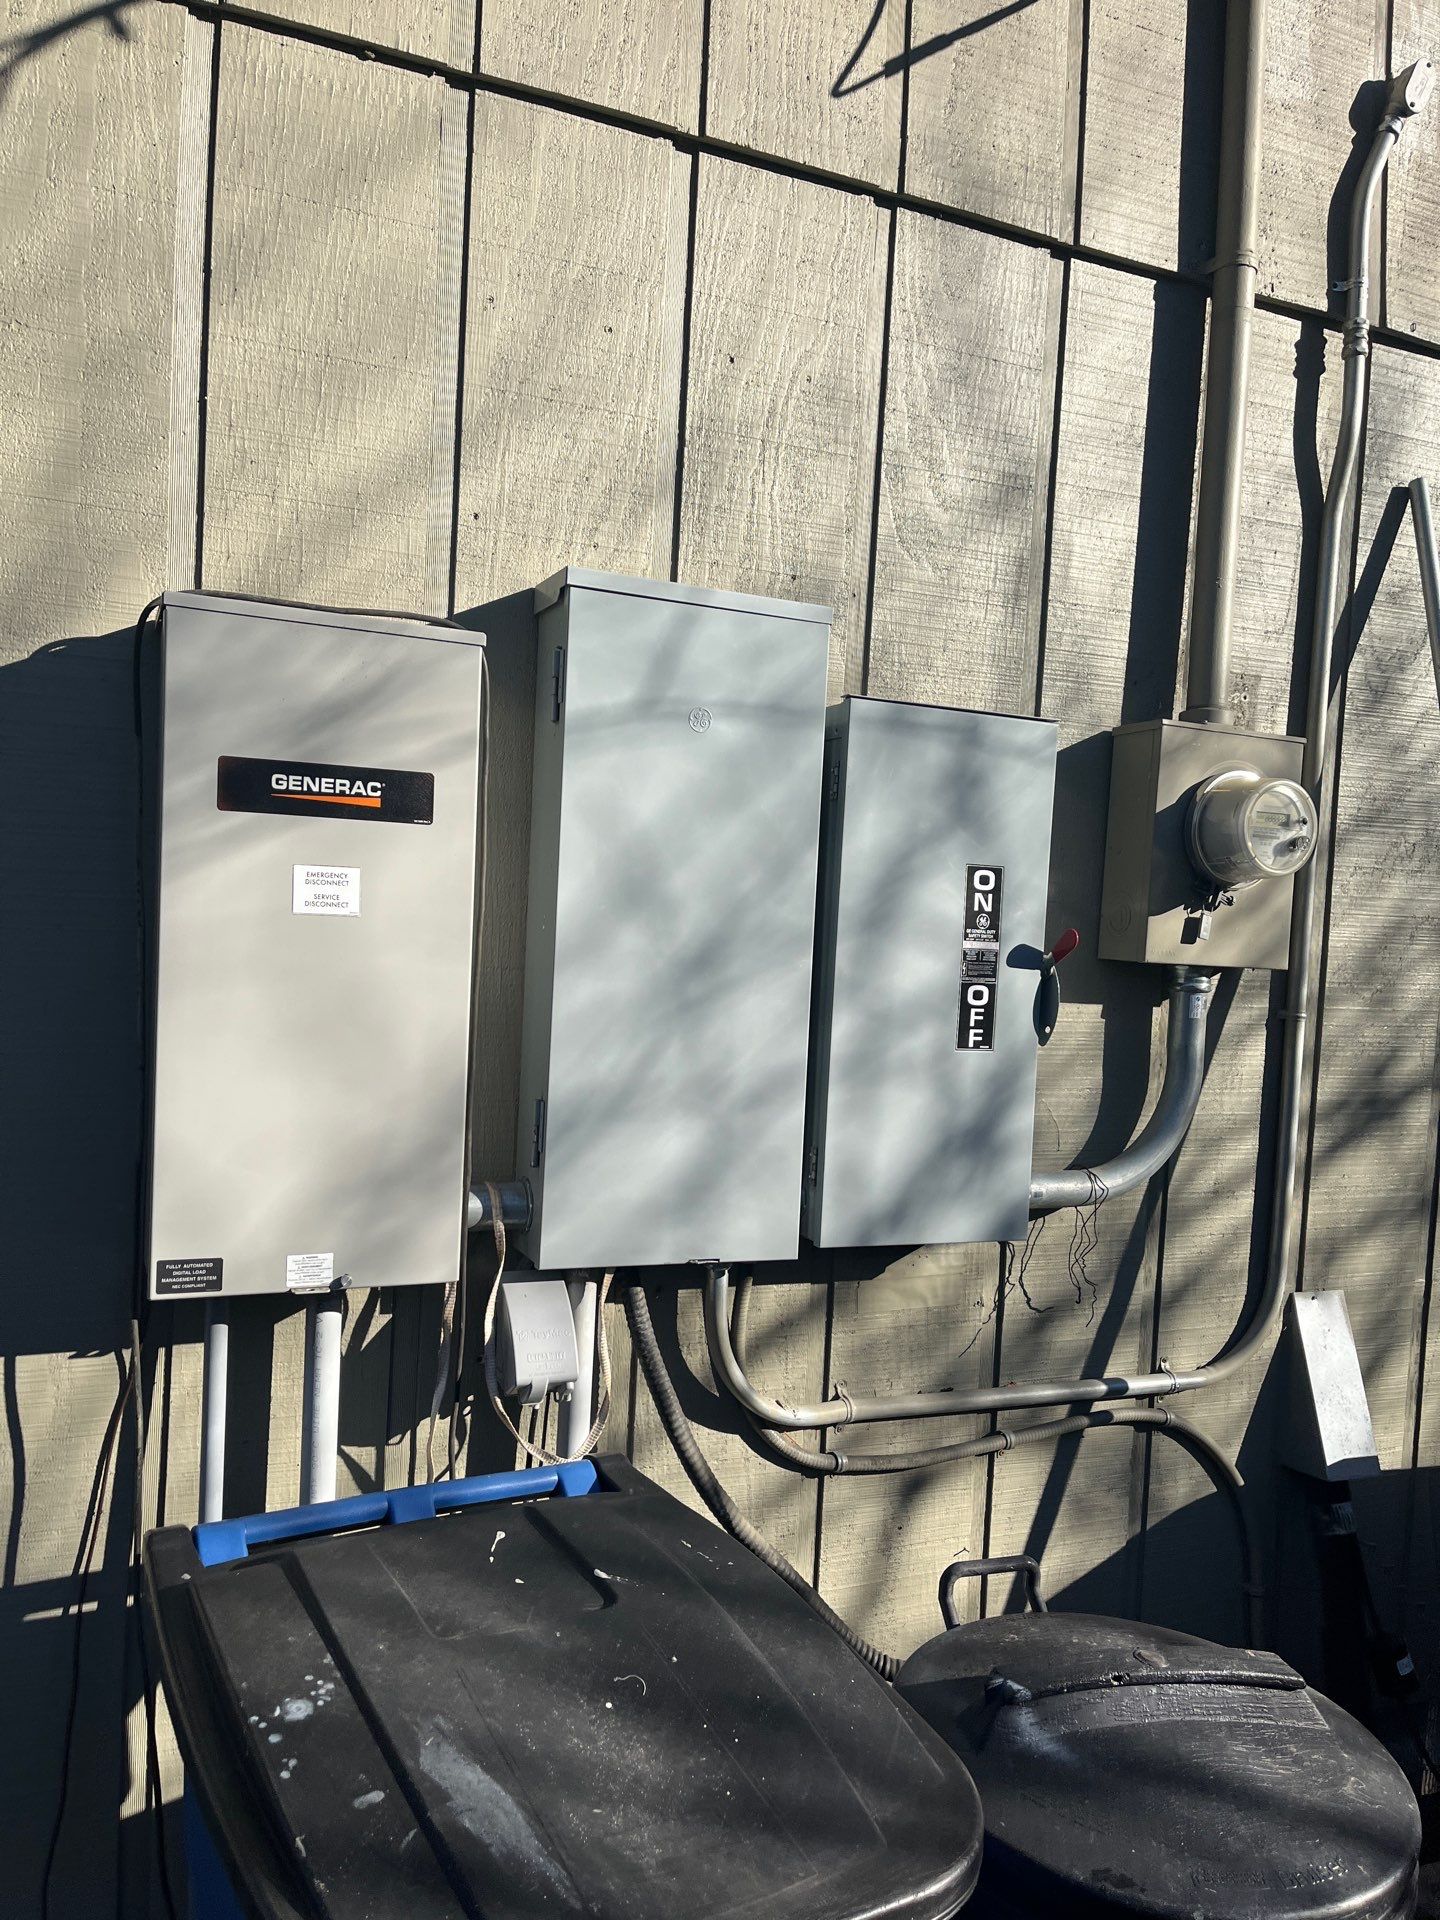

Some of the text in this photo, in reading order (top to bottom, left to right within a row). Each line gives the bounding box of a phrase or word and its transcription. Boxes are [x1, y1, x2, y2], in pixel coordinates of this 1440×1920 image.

[271, 773, 381, 797] GENERAC
[306, 871, 349, 879] EMERGENCY
[305, 878, 349, 887] DISCONNECT
[973, 869, 996, 912] ON
[313, 893, 340, 901] SERVICE
[304, 900, 349, 909] DISCONNECT
[967, 984, 990, 1048] OFF
